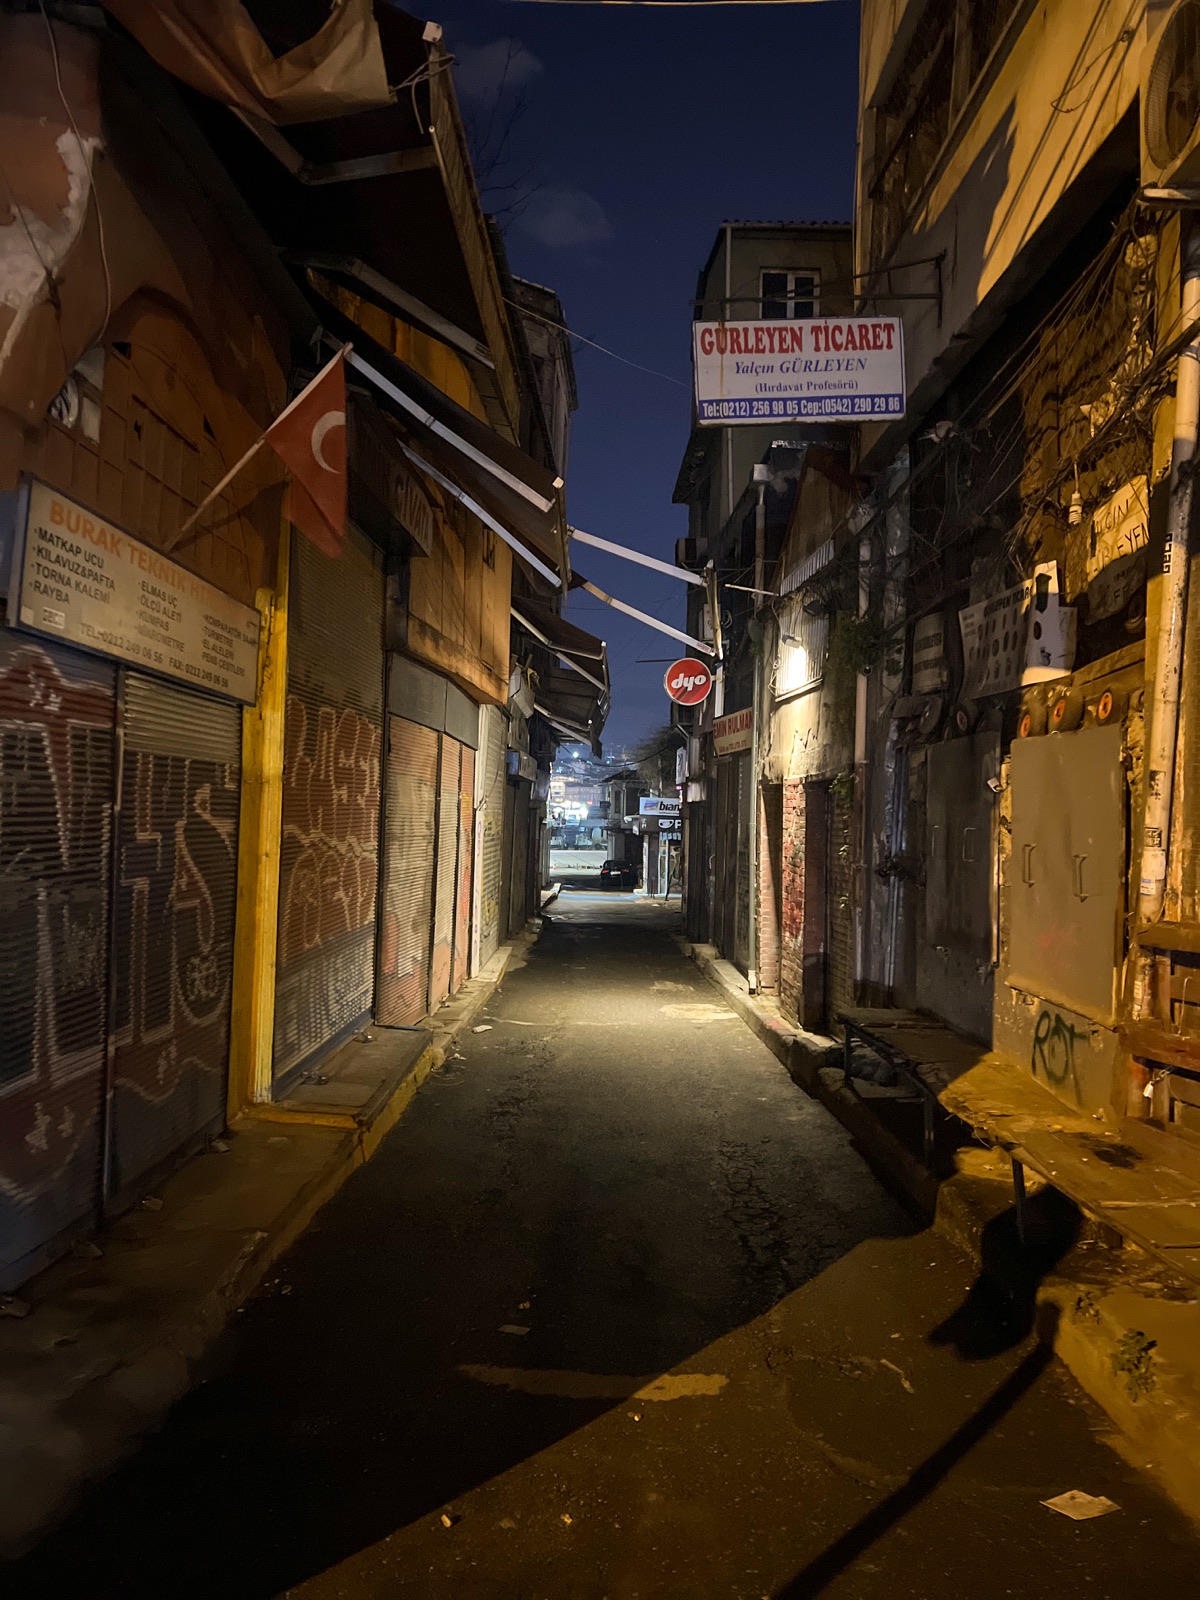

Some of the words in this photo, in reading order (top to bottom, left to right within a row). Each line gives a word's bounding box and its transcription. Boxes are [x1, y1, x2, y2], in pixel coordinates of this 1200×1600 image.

[810, 320, 895, 352] TİCARET
[735, 361, 774, 376] Yalçın
[779, 358, 867, 374] GÜRLEYEN
[755, 382, 803, 394] (Hırdavat
[806, 380, 859, 392] Profesörü)
[702, 401, 750, 418] Tel:(0212)
[752, 401, 770, 416] 256
[772, 400, 785, 415] 98
[786, 400, 799, 415] 05
[800, 398, 852, 416] Cep:(0542)
[854, 397, 872, 412] 290
[874, 397, 886, 412] 29
[888, 396, 901, 411] 86
[49, 499, 122, 558] BURAK
[38, 526, 81, 557] MATKAP
[83, 549, 104, 569] UCU
[35, 561, 72, 589] TORNA
[33, 580, 70, 604] RAYBA
[671, 673, 707, 692] dyo
